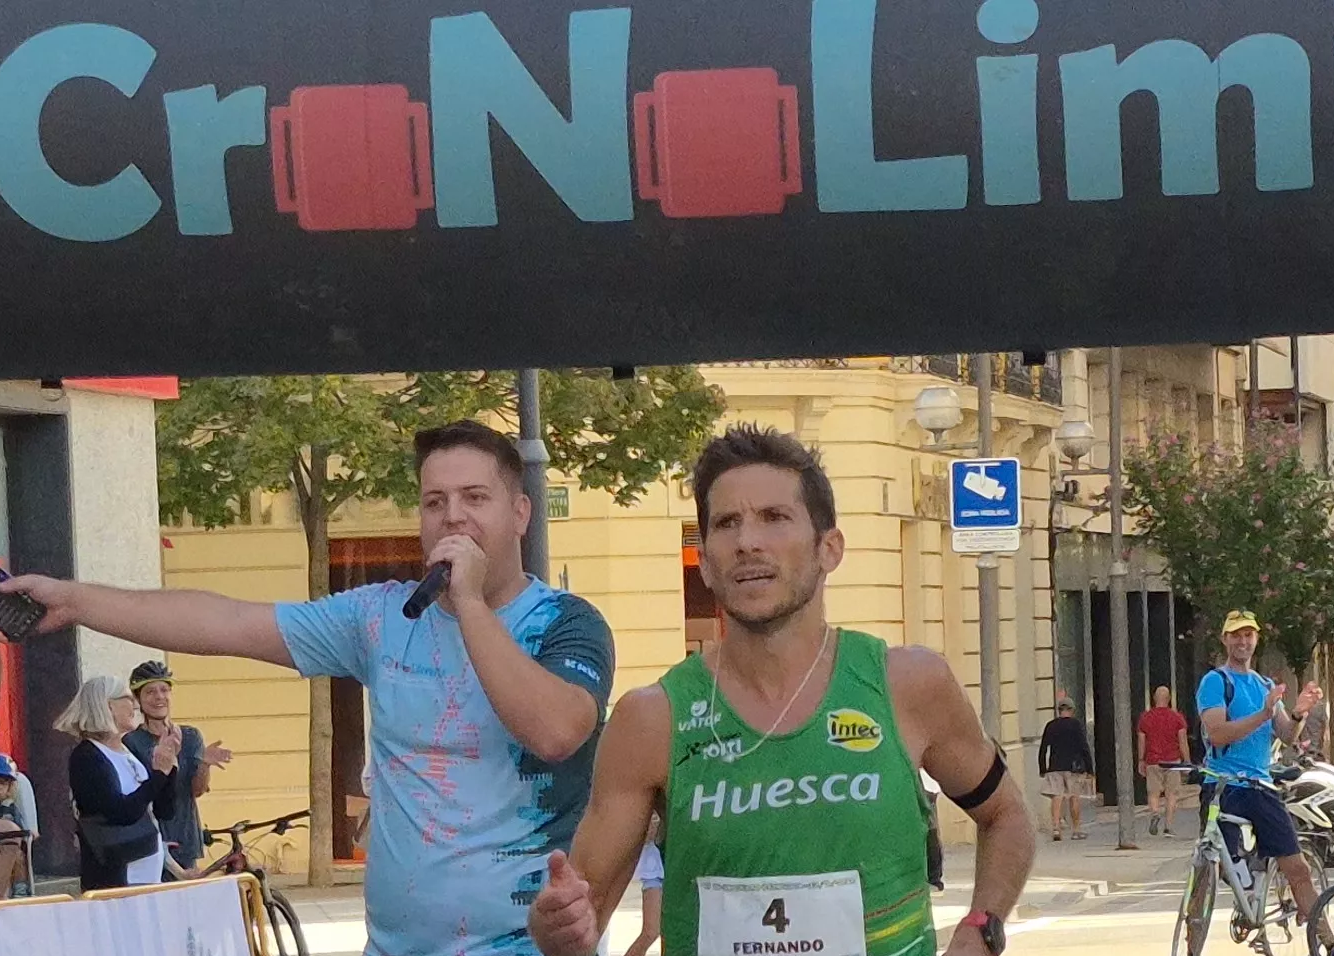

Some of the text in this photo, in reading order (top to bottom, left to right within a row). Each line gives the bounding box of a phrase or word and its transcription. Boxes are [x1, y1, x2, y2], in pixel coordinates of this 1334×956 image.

[691, 772, 881, 822] Huesca
[762, 898, 791, 934] 4
[733, 939, 825, 956] FERNANDO
